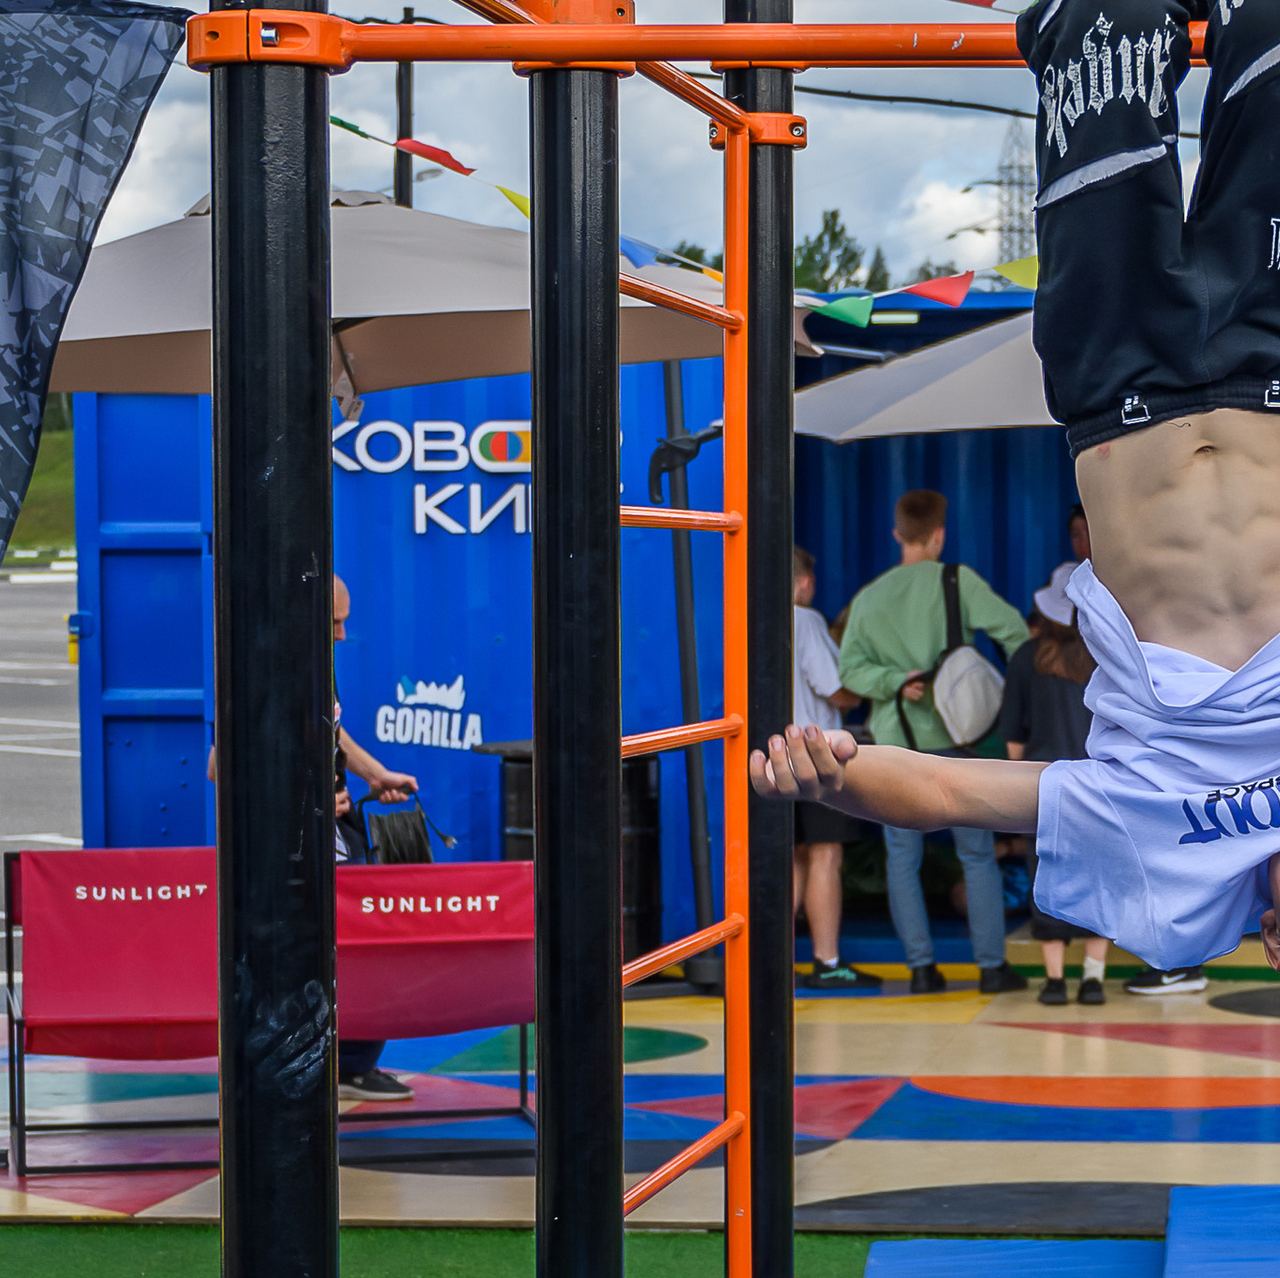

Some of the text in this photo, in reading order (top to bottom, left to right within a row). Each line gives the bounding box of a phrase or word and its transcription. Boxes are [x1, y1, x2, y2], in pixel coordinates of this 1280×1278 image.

[376, 704, 483, 750] GORILLA
[75, 883, 208, 901] SUNLIGHT
[361, 894, 501, 914] SUNLIGHT
